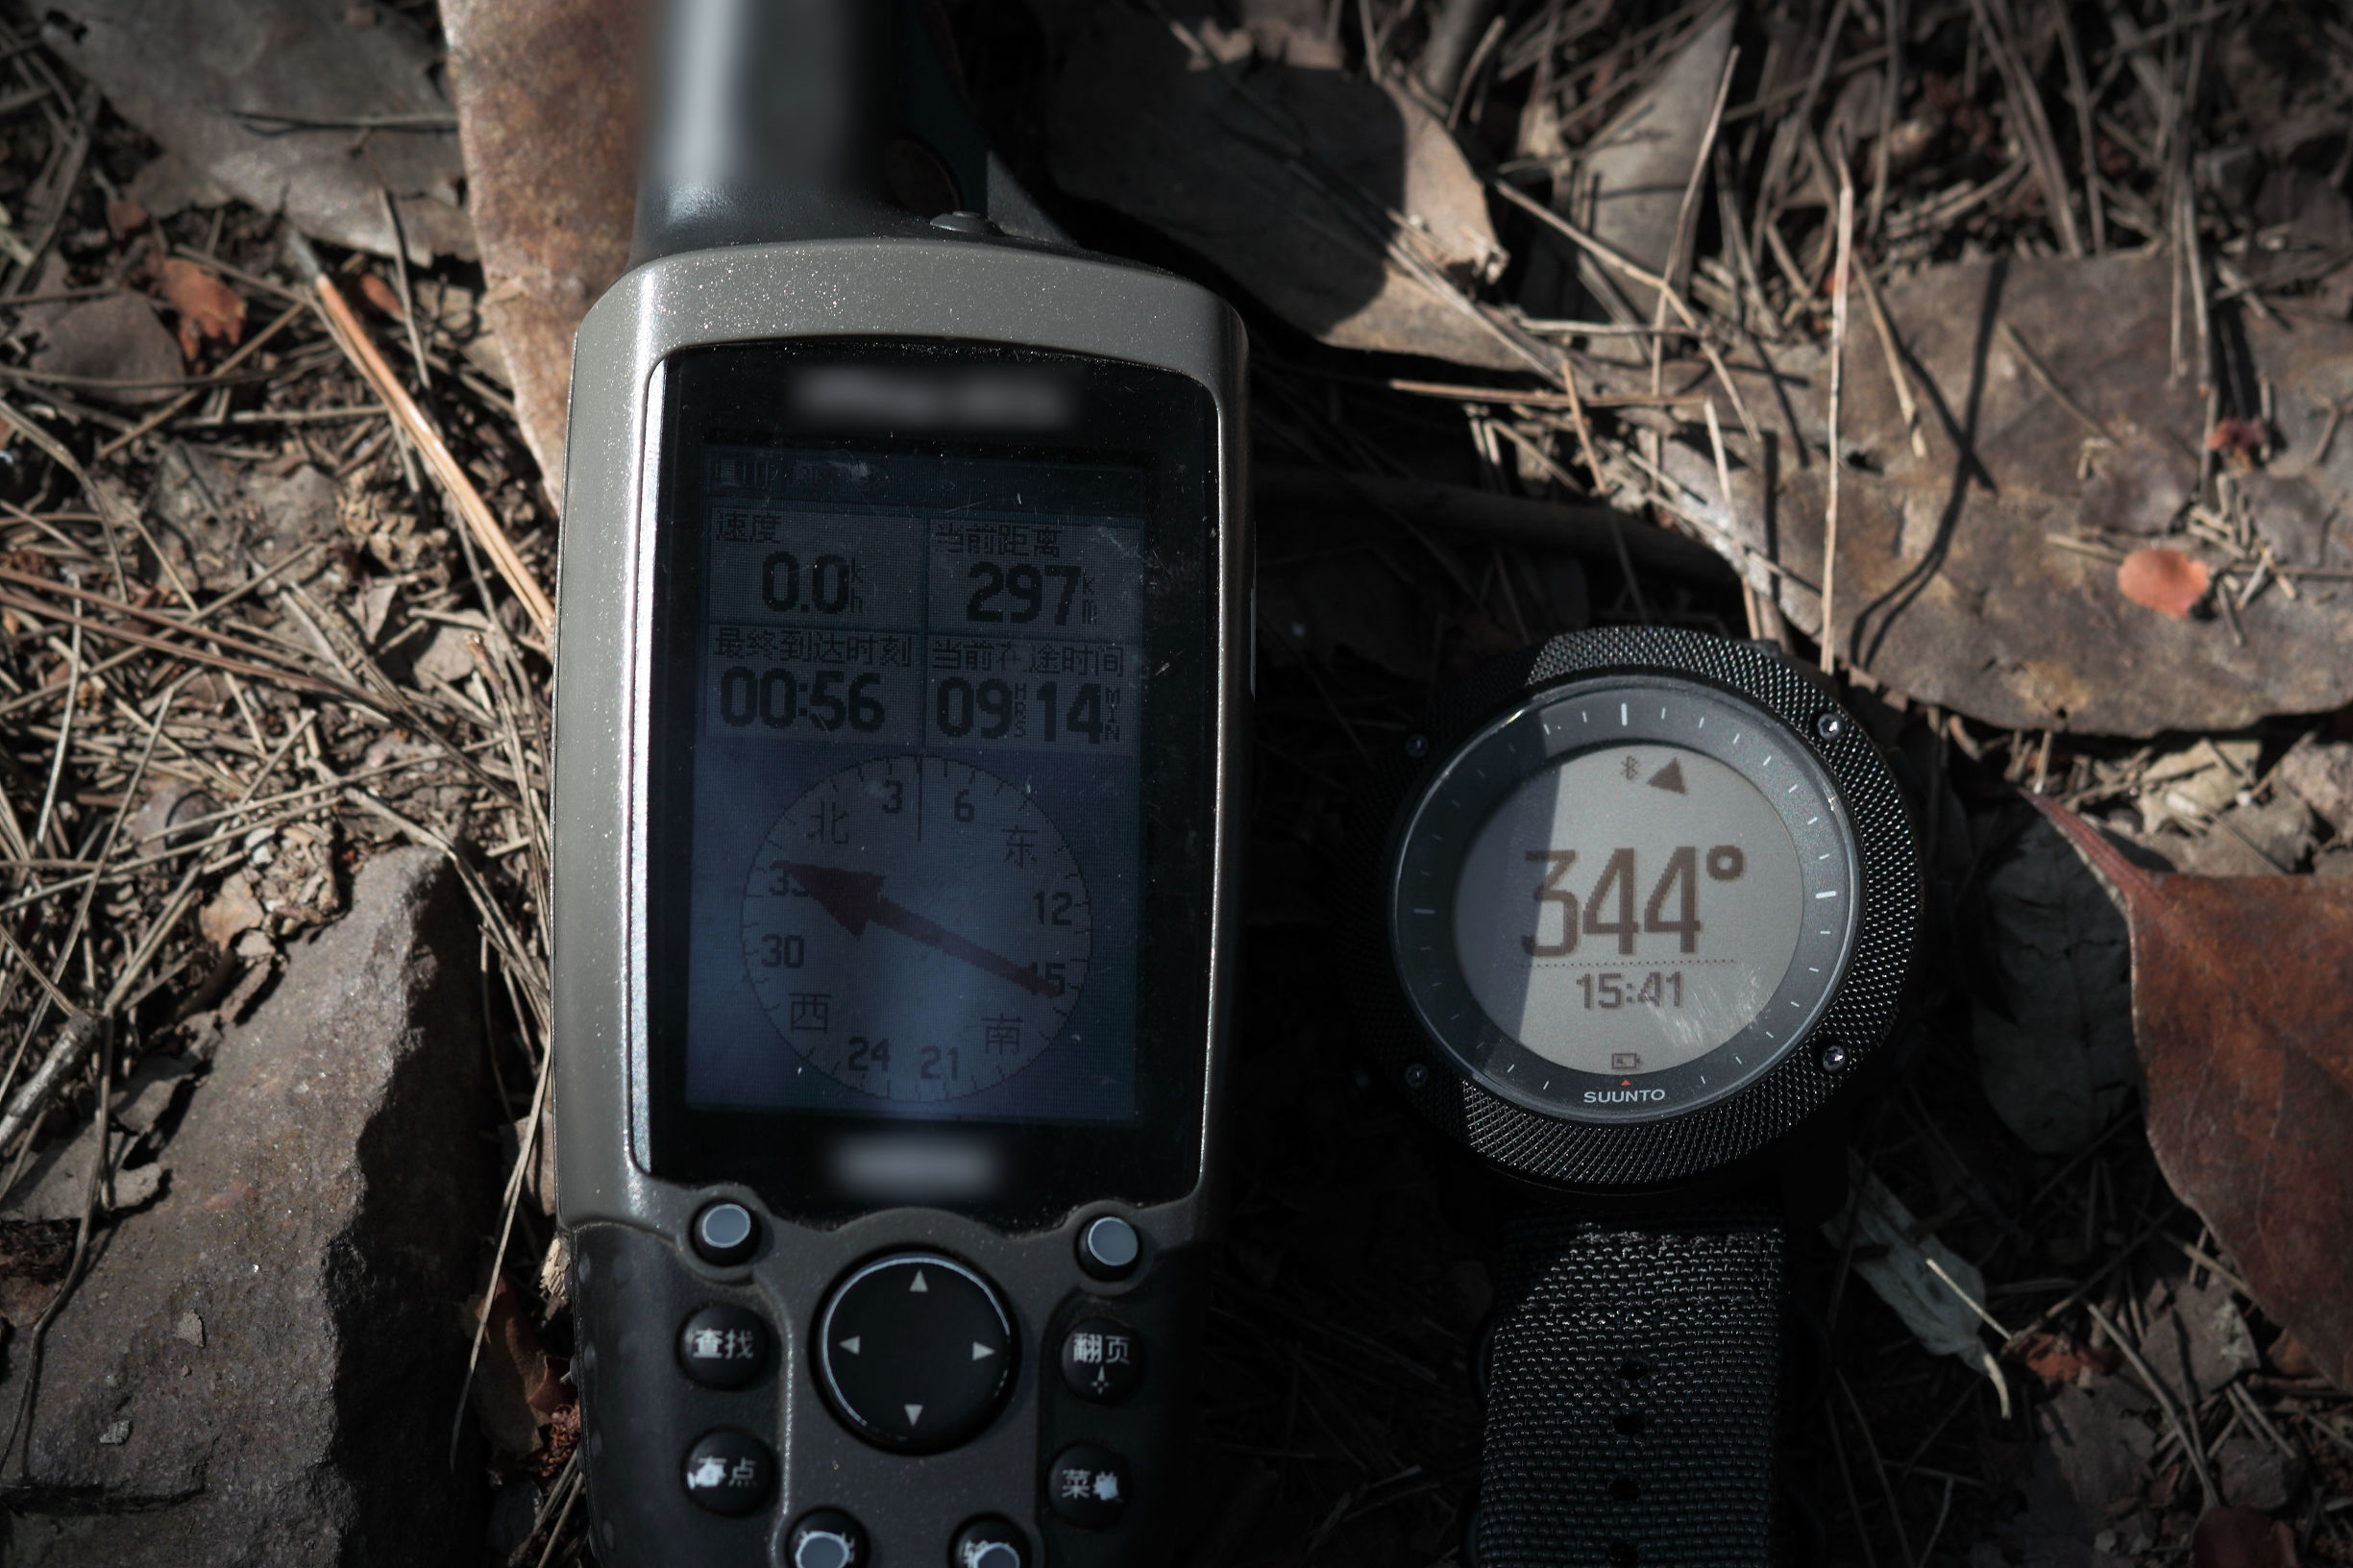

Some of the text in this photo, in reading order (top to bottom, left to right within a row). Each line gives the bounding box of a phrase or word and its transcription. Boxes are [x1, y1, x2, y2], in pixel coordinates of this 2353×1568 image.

[716, 511, 782, 545] 速度
[938, 522, 1062, 558] 当前距离
[762, 551, 849, 615] 0.0
[967, 562, 1082, 626] 297
[714, 627, 913, 668] 最终到达时刻
[720, 666, 886, 731] 00:56
[937, 677, 1014, 740] 09
[1036, 681, 1103, 745] 14
[882, 779, 903, 814] 3
[954, 789, 974, 823] 6
[807, 801, 849, 845] 北
[1002, 827, 1039, 868] 东
[1032, 892, 1074, 926] 12
[1522, 845, 1745, 958] 344°
[761, 934, 805, 968] 30
[1576, 970, 1684, 1011] 15:41
[789, 992, 832, 1034] 西
[848, 1037, 891, 1072] 24
[981, 1014, 1024, 1055] 南
[920, 1045, 959, 1080] 21
[1582, 1088, 1666, 1104] SUUNTO
[693, 1328, 753, 1360] 查找
[1072, 1332, 1130, 1365] 翻页
